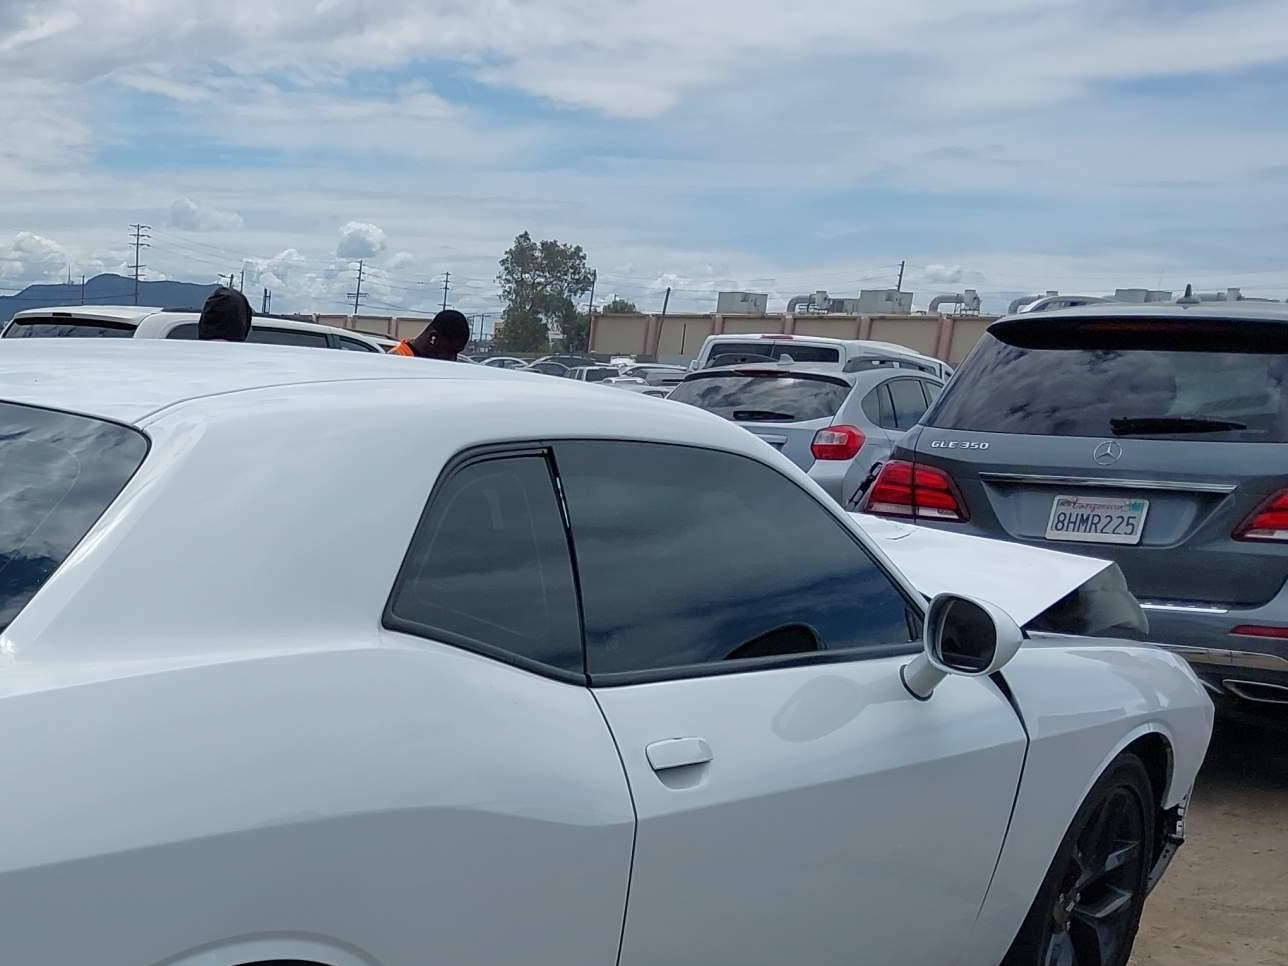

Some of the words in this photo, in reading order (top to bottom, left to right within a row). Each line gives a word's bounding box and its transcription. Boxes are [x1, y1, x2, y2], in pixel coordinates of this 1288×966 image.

[931, 440, 959, 448] GLE
[960, 441, 989, 450] 350
[1054, 511, 1137, 536] 8HMR225
